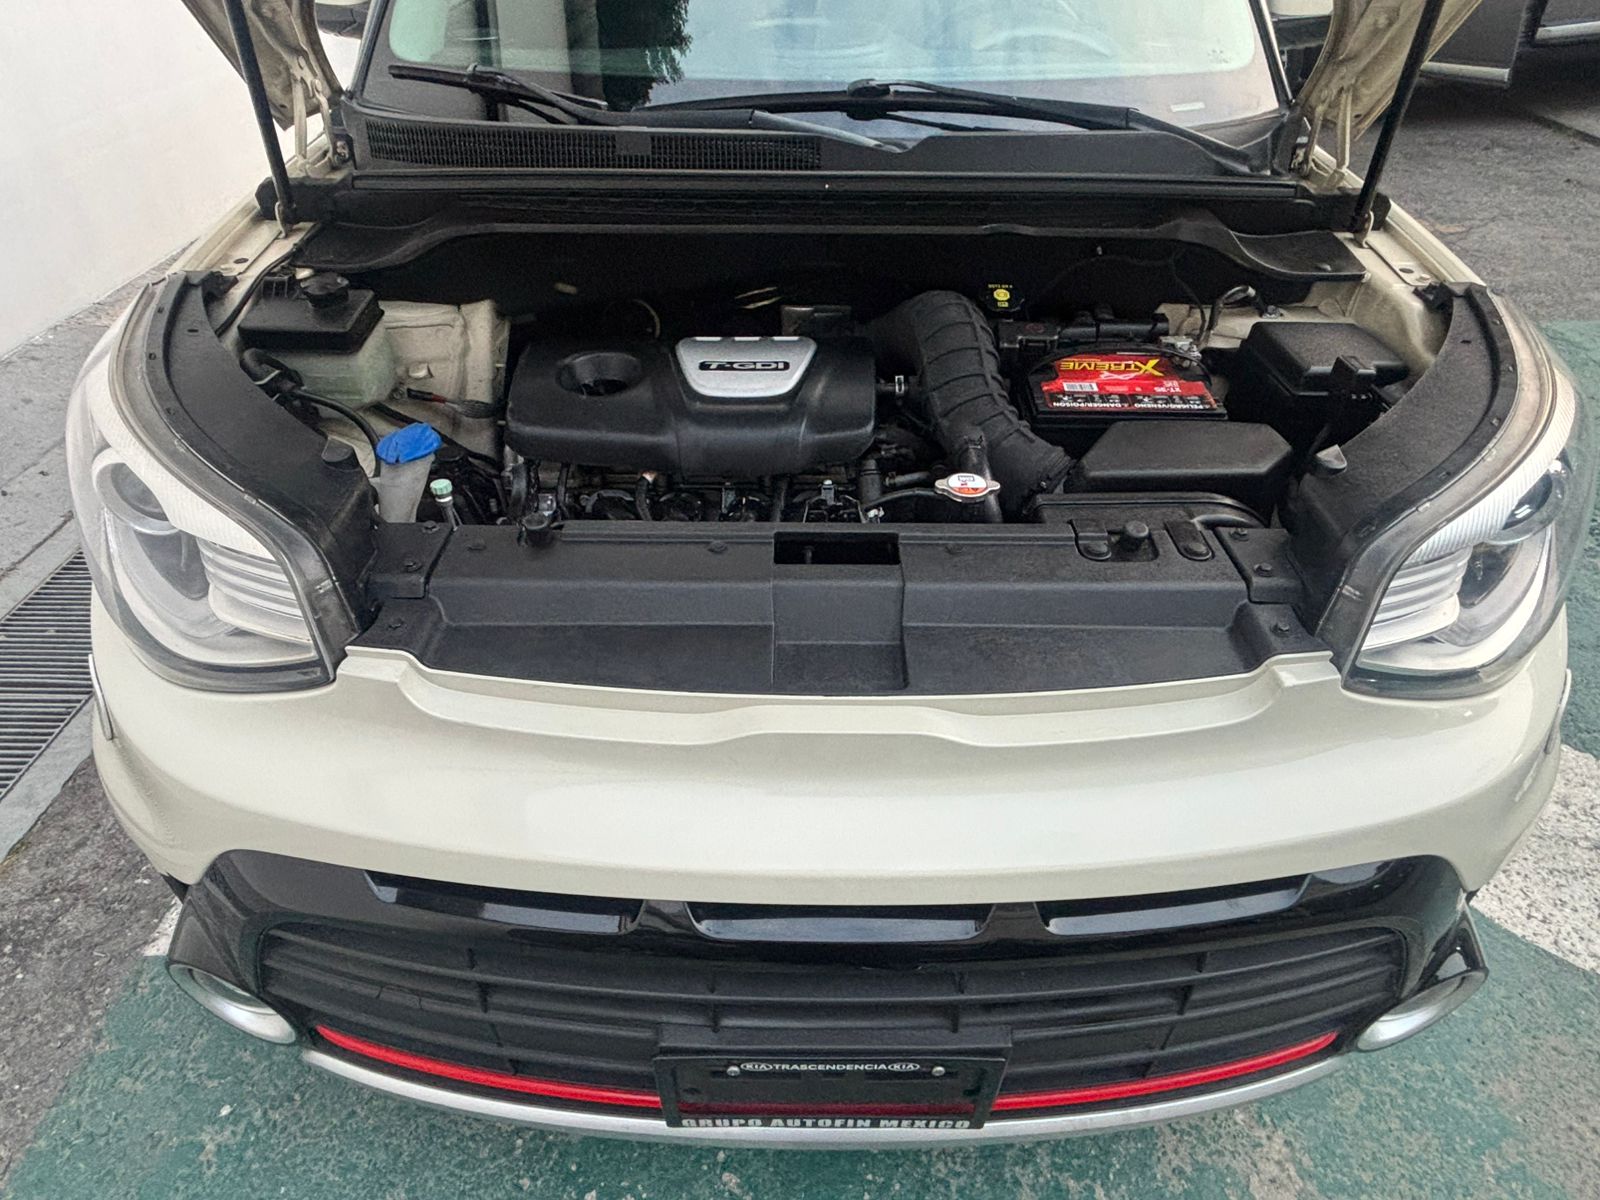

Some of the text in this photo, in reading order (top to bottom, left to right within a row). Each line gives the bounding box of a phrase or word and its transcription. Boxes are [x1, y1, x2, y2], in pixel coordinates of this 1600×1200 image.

[1060, 359, 1164, 377] XTREME
[742, 1062, 919, 1071] KIA TRASCENDENCIA KIA
[681, 1119, 970, 1129] GRUPO AUTOFIN MEXICO
